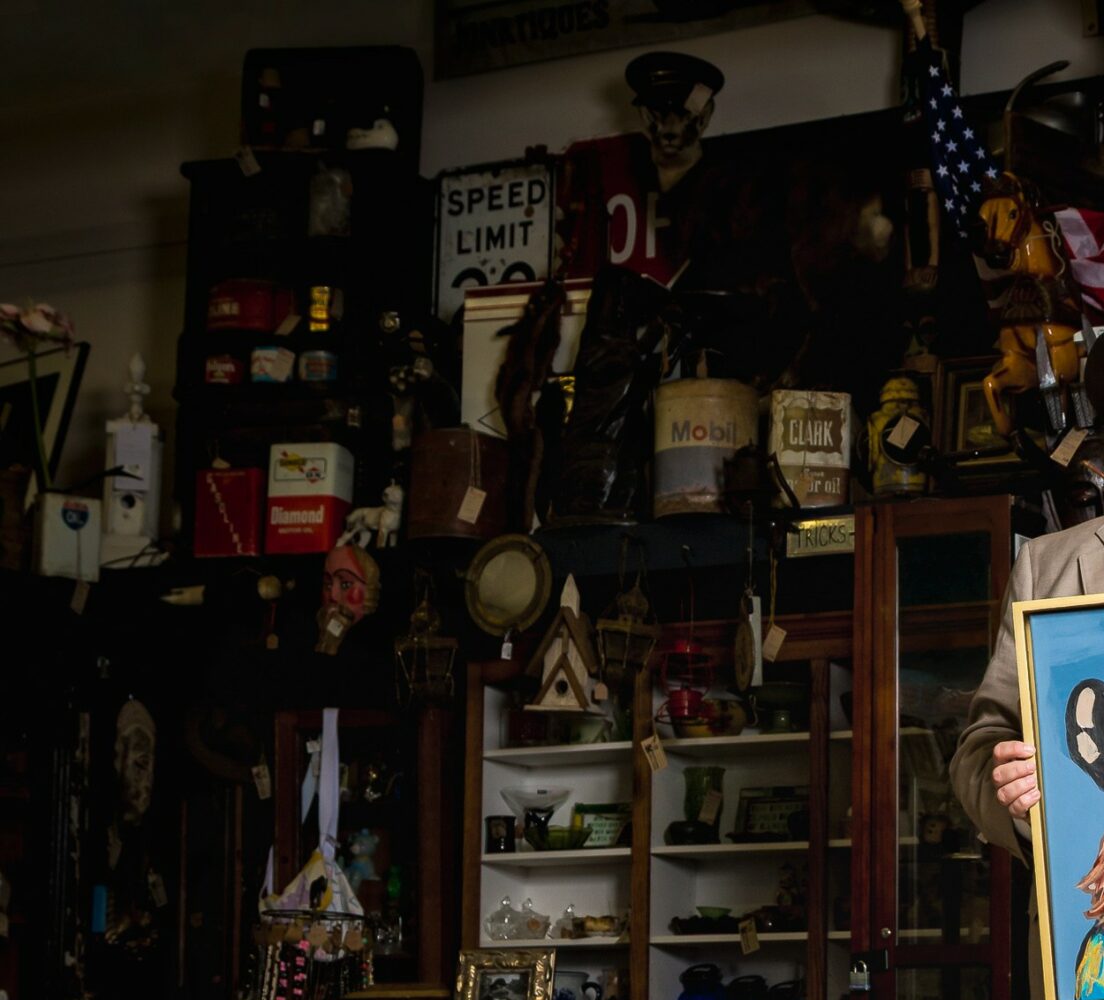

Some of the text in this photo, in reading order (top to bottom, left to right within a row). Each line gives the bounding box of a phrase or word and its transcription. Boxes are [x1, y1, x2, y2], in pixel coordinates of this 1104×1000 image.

[448, 179, 546, 216] SPEED
[457, 220, 533, 255] LIMIT
[671, 419, 736, 443] Mobil
[789, 419, 834, 448] CLARK
[824, 477, 841, 494] oil
[270, 504, 325, 525] Diamond
[796, 524, 847, 548] TRICKS
